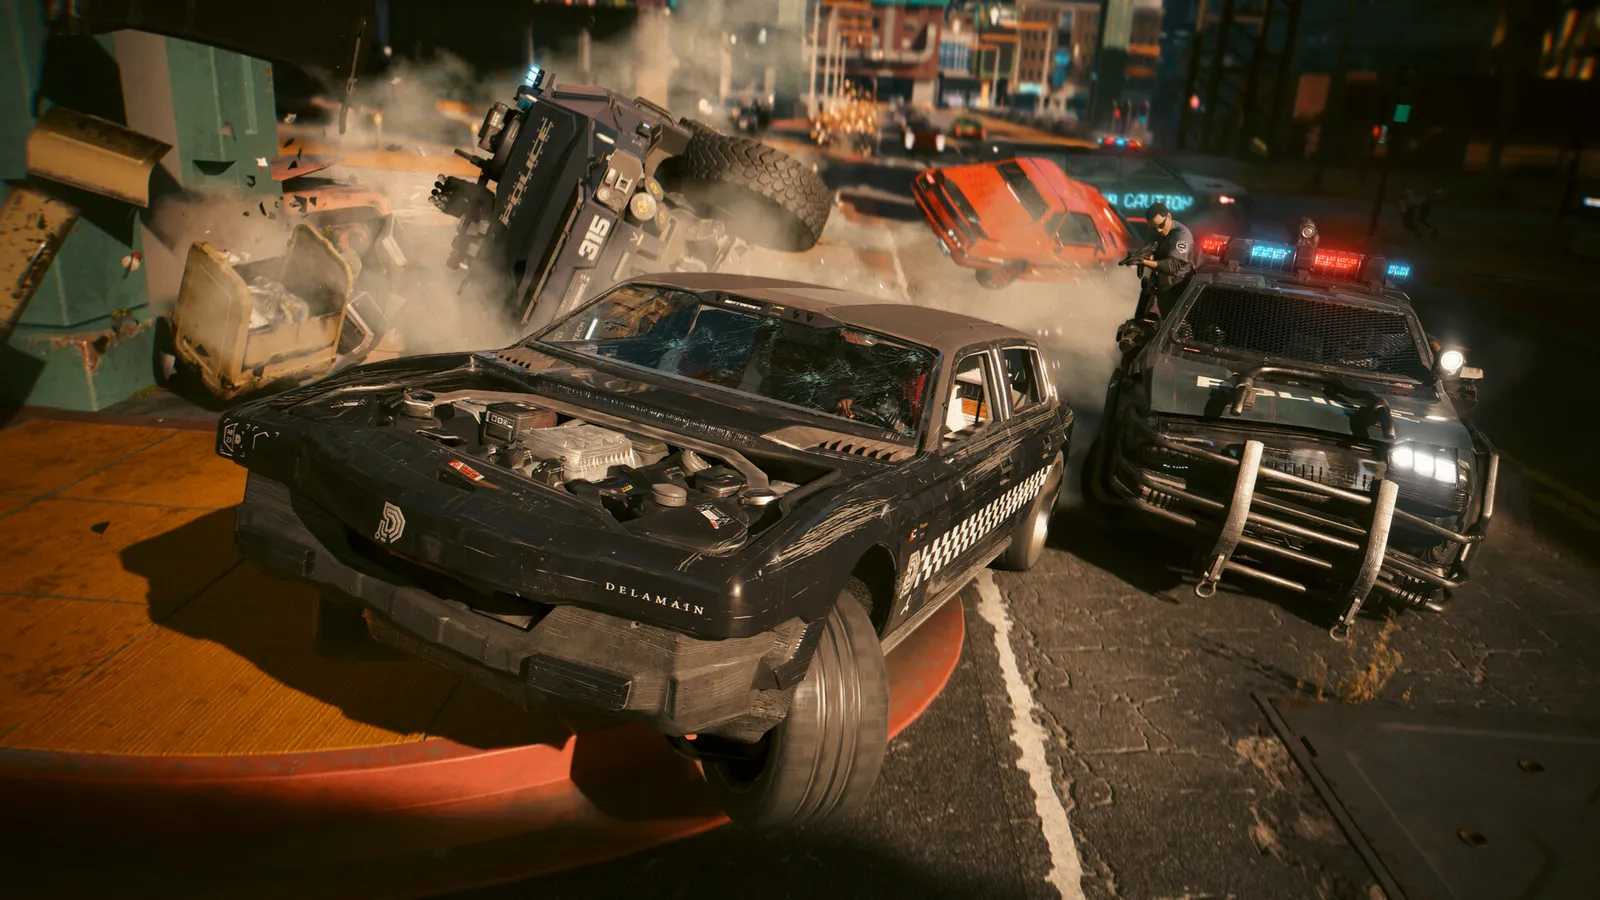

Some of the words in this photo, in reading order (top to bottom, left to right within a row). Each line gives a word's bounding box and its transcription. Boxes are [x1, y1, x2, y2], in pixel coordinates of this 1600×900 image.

[500, 118, 552, 226] POLICE
[1123, 192, 1195, 212] CAUTION
[578, 214, 611, 261] 315
[605, 582, 704, 615] DELAMAIN
